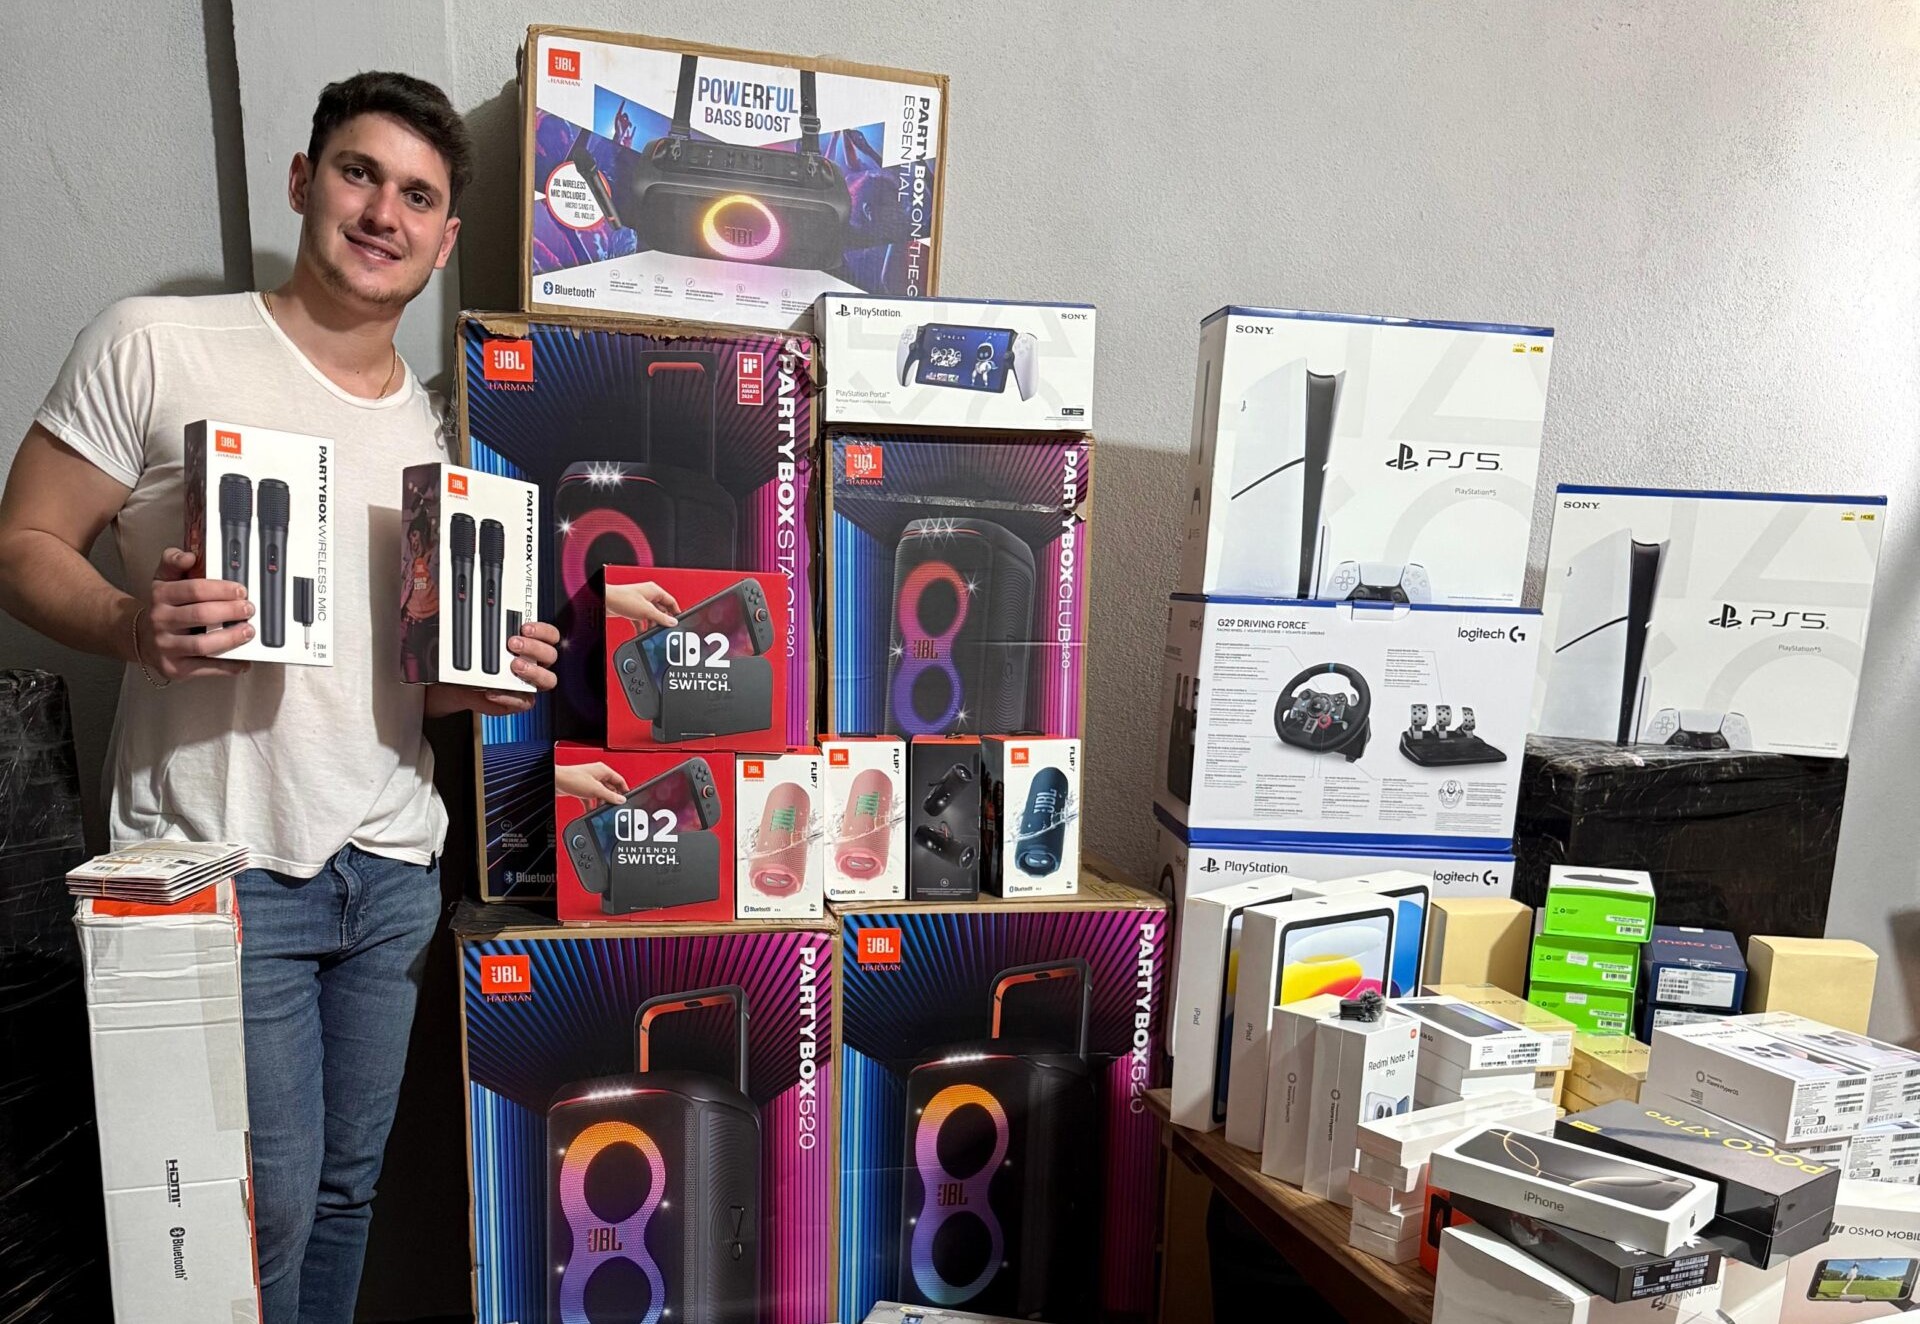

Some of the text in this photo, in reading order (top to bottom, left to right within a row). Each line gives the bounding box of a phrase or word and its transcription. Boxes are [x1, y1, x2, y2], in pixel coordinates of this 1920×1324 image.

[555, 56, 576, 72] JBL
[698, 76, 798, 114] POWERFUL
[705, 107, 790, 133] BASS BOOST
[898, 95, 916, 203] ESSENTIAL
[562, 179, 587, 190] WIRELESS
[551, 189, 586, 201] MIC INCLUDED
[554, 284, 597, 298] Bluetooth
[853, 306, 901, 319] PlayStation
[1235, 325, 1274, 335] SONY
[493, 350, 525, 370] JBL
[489, 382, 534, 391] HARMAN
[836, 389, 868, 398] PlayStation
[221, 436, 238, 448] JBL
[1427, 449, 1502, 471] PS5
[452, 479, 465, 490] JBL
[1563, 501, 1600, 509] SONY
[317, 597, 327, 622] MIC
[1217, 618, 1236, 628] G29
[1237, 620, 1275, 629] DRIVING
[1750, 609, 1829, 629] PS5
[1457, 626, 1505, 642] logitech
[704, 632, 730, 668] 2
[913, 639, 939, 659] JBL
[669, 672, 728, 680] NINTENDO
[669, 679, 729, 692] SWITCH
[1033, 788, 1057, 814] JBL
[652, 808, 678, 842] 2
[618, 846, 676, 854] NINTENDO
[618, 854, 677, 865] SWITCH
[1224, 860, 1289, 875] PlayStation
[1433, 870, 1479, 885] logitech
[867, 937, 894, 954] JBL
[1657, 938, 1705, 948] moto
[491, 965, 522, 983] JBL
[861, 963, 901, 971] HARMAN
[486, 994, 531, 1002] HARMAN
[1193, 1007, 1201, 1026] iPad
[1245, 1022, 1253, 1041] iPad
[1368, 1049, 1415, 1071] Redmi Note 14
[1386, 1069, 1396, 1077] Pro
[1645, 1110, 1828, 1175] POCO X7 Pro
[938, 1183, 967, 1206] JBL
[1523, 1190, 1565, 1212] iPhone
[1848, 1226, 1884, 1238] OSMO
[588, 1228, 622, 1252] JBL
[172, 1238, 186, 1279] Bluetooth
[1675, 1290, 1694, 1301] MINI
